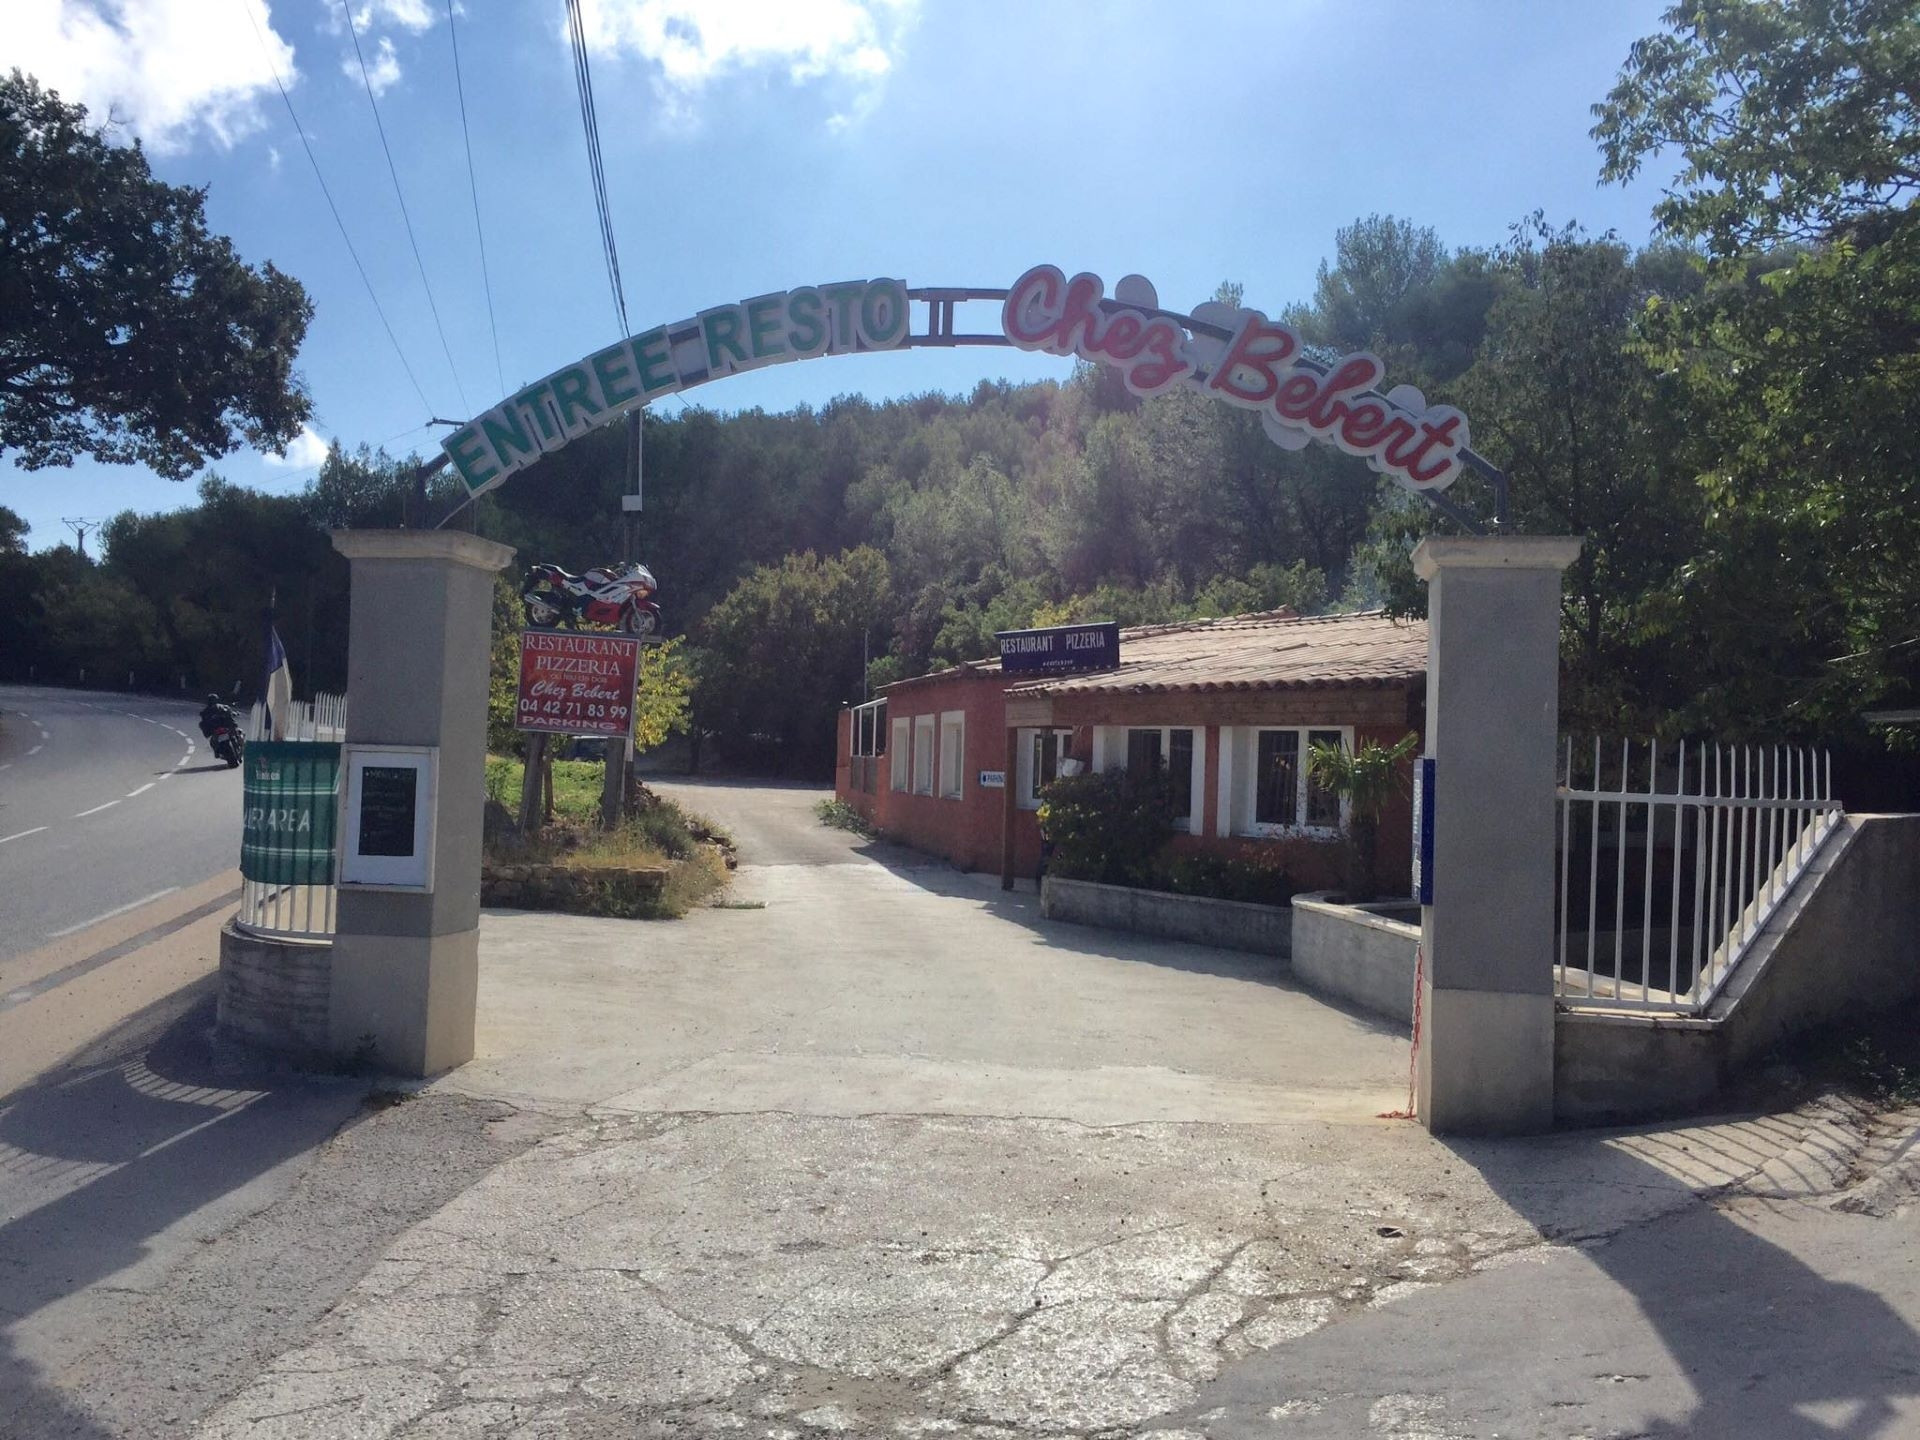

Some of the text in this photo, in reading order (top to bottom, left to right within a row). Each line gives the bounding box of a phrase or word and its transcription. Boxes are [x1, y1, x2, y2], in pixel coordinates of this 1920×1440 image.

[1005, 268, 1462, 483] Chez Bebert
[445, 279, 903, 494] ENTREE RESTO
[525, 634, 634, 656] RESTAURANT
[1001, 631, 1105, 654] RESTAURANT PIZZERIA
[535, 655, 621, 675] PIZZERIA
[530, 680, 620, 699] Chez Bebert
[520, 698, 627, 719] 04 42 71 83 99
[521, 716, 617, 730] PARKING
